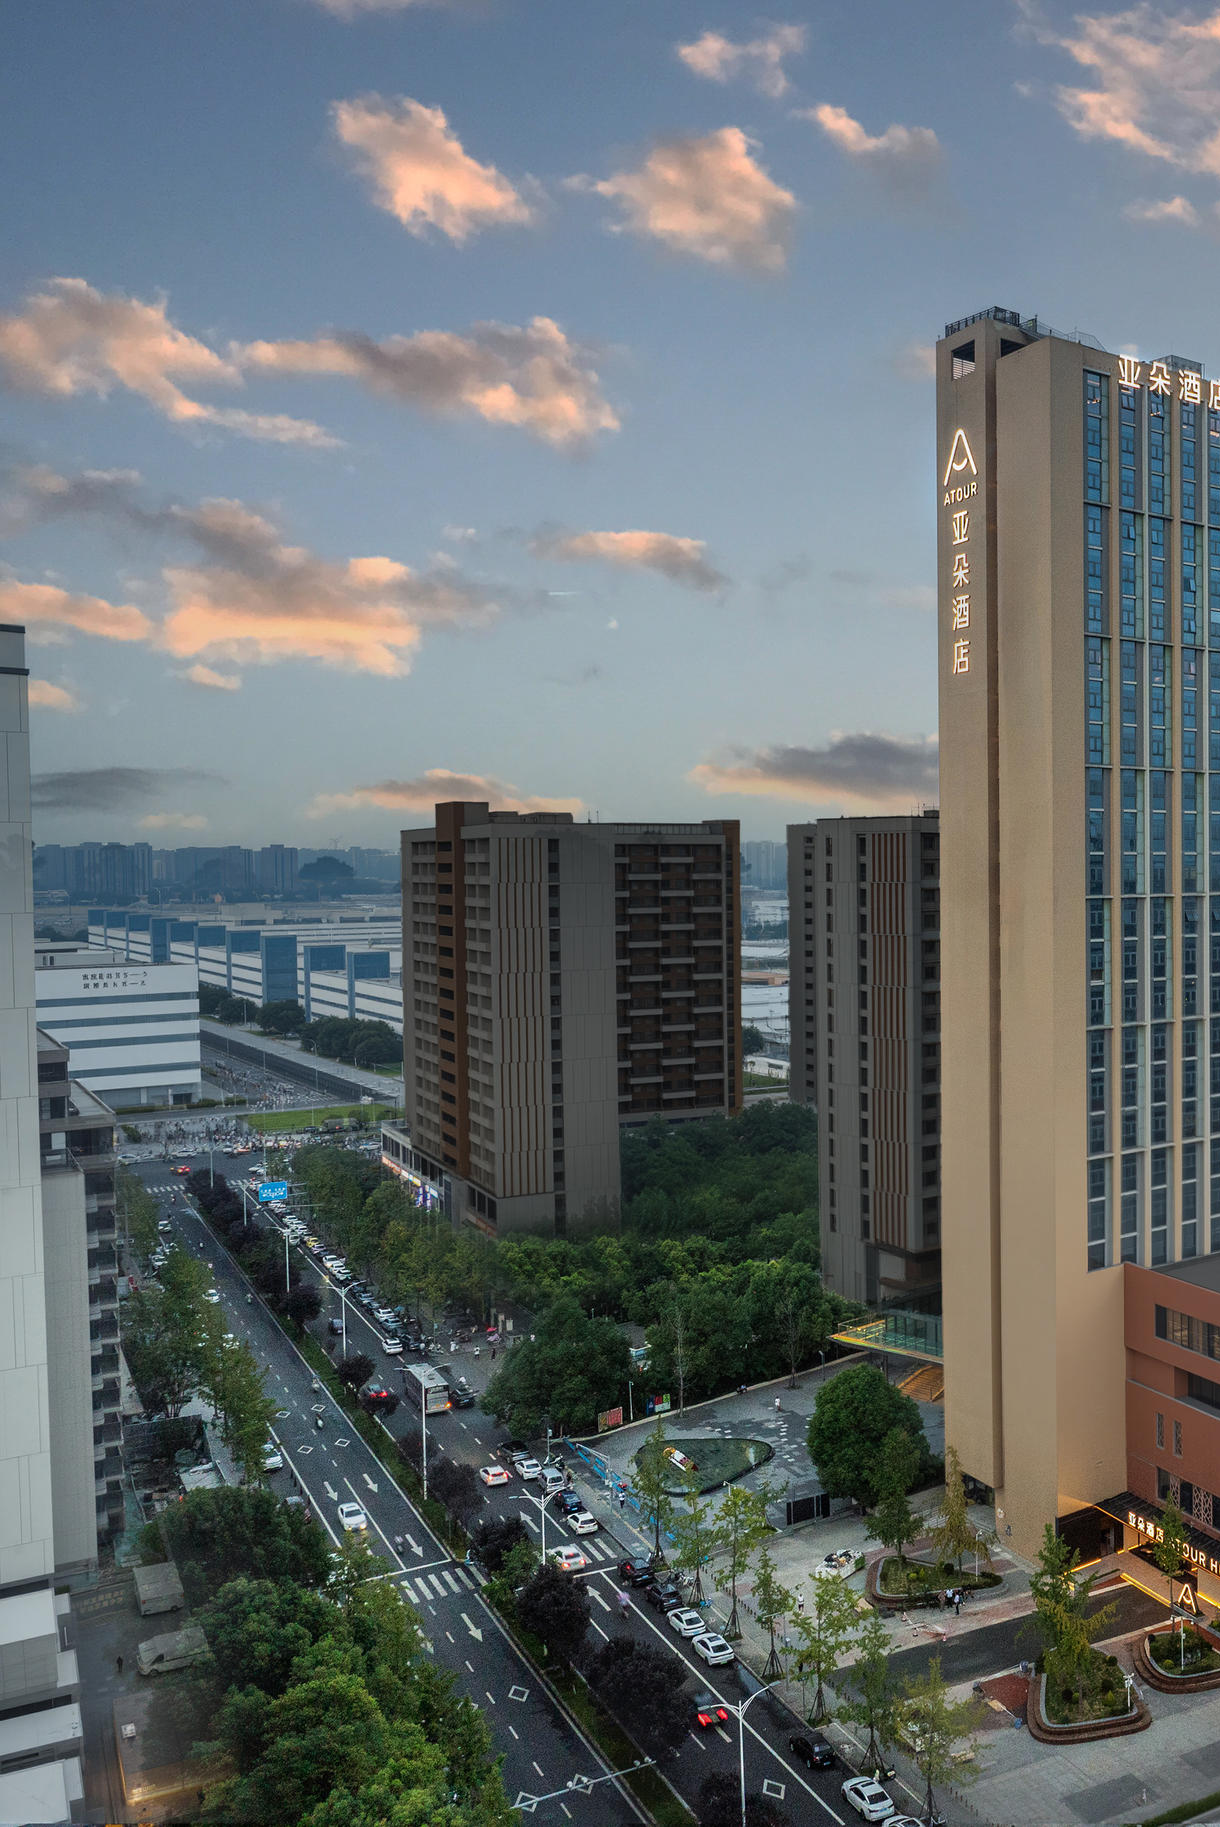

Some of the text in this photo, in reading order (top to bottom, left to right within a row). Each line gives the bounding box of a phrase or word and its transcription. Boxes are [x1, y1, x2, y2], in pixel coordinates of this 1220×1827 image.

[943, 481, 977, 506] ATOUR
[952, 510, 970, 675] 亚朵酒店
